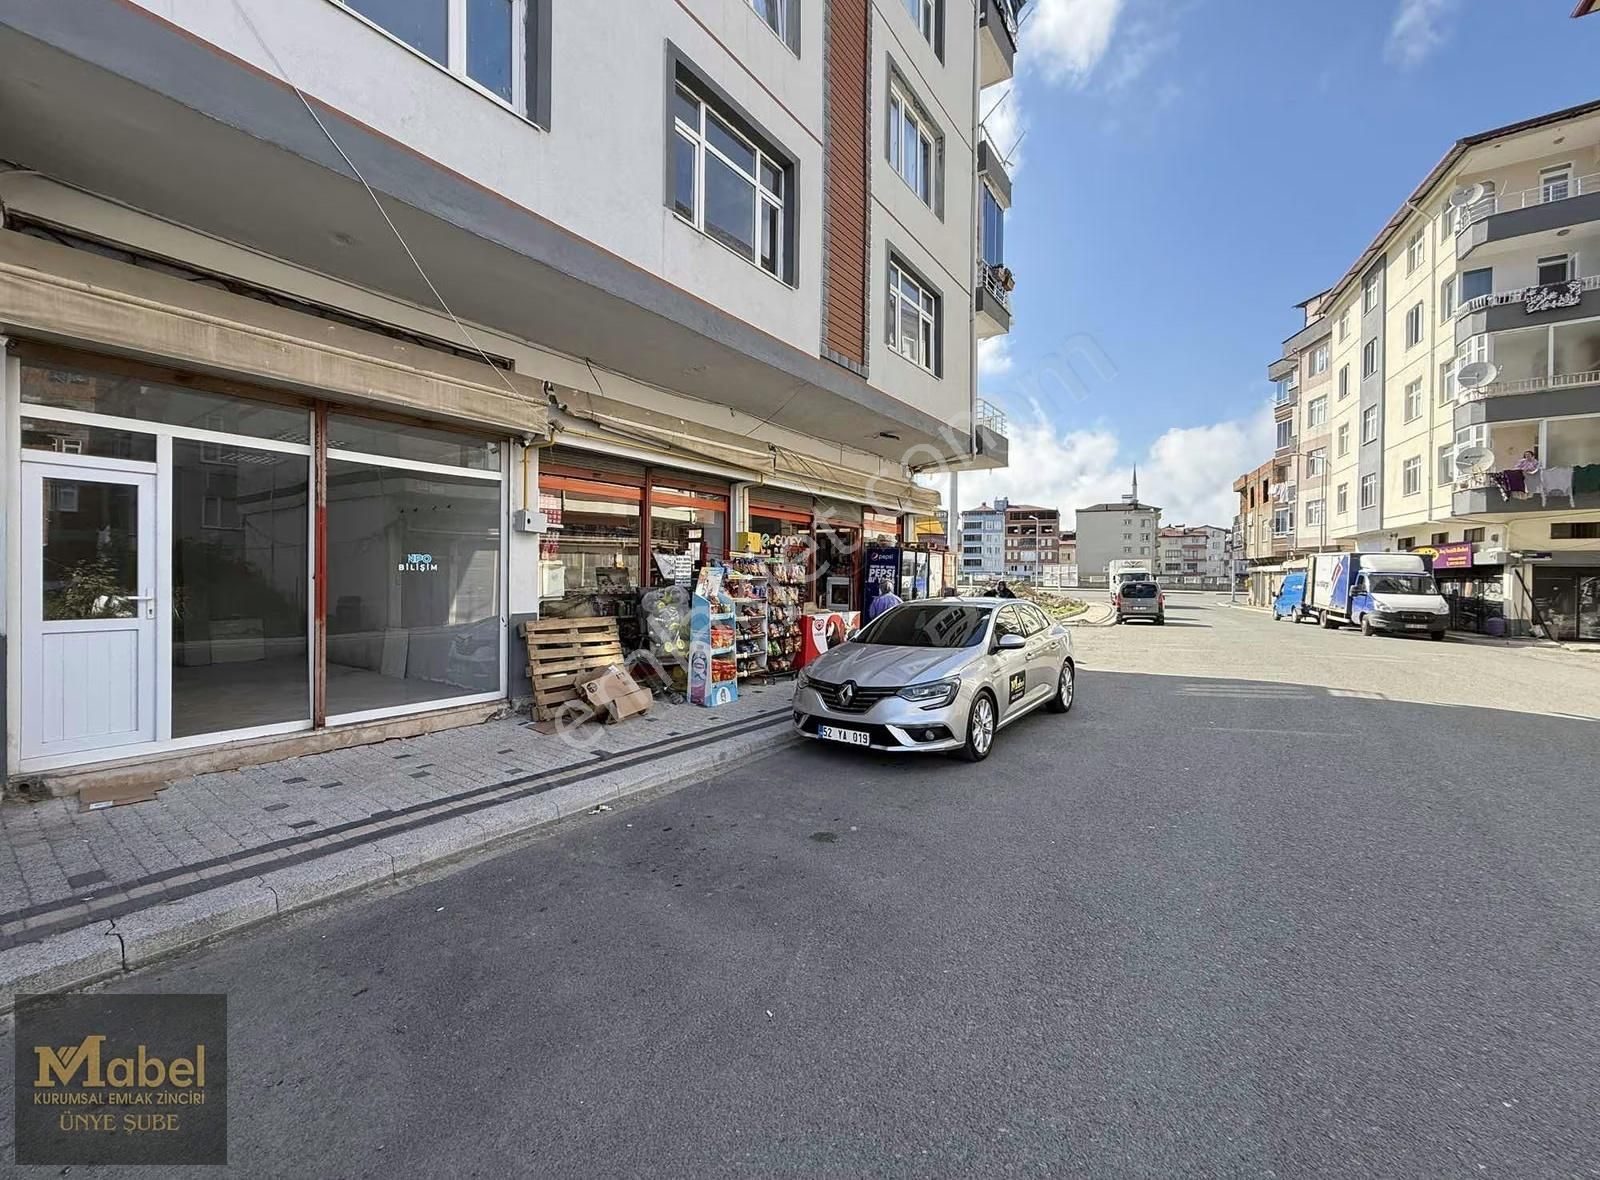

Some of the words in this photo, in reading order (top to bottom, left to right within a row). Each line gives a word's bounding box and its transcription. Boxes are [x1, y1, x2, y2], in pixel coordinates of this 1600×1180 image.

[823, 727, 833, 738] 52
[838, 729, 847, 740] YA
[852, 732, 868, 744] 019
